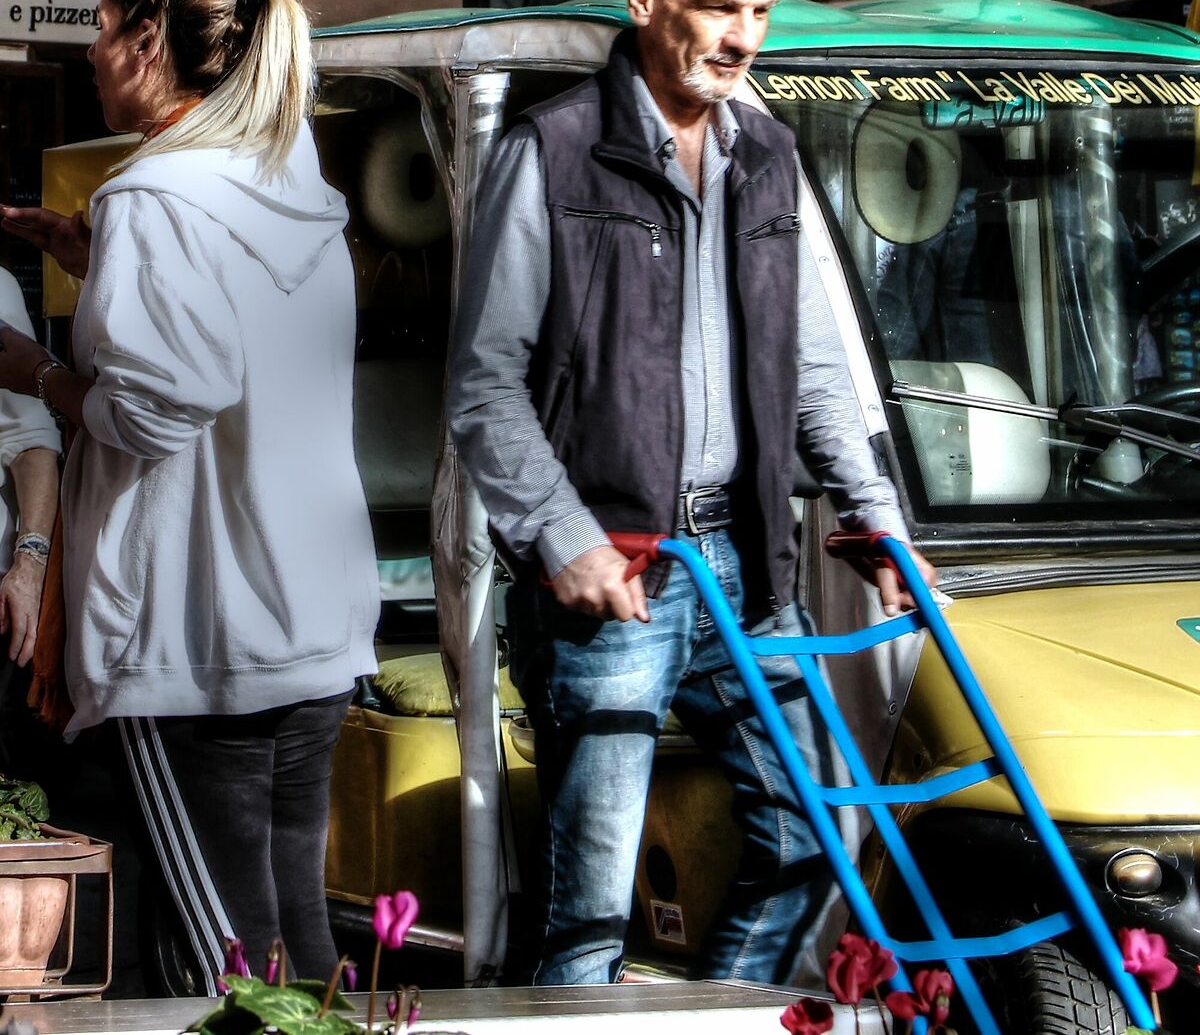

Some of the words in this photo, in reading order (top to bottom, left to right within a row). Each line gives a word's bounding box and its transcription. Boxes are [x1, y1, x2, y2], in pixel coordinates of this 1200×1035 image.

[10, 4, 22, 22] e
[744, 71, 865, 101] Lemon
[999, 71, 1092, 104] Valle
[1080, 72, 1152, 104] Dei
